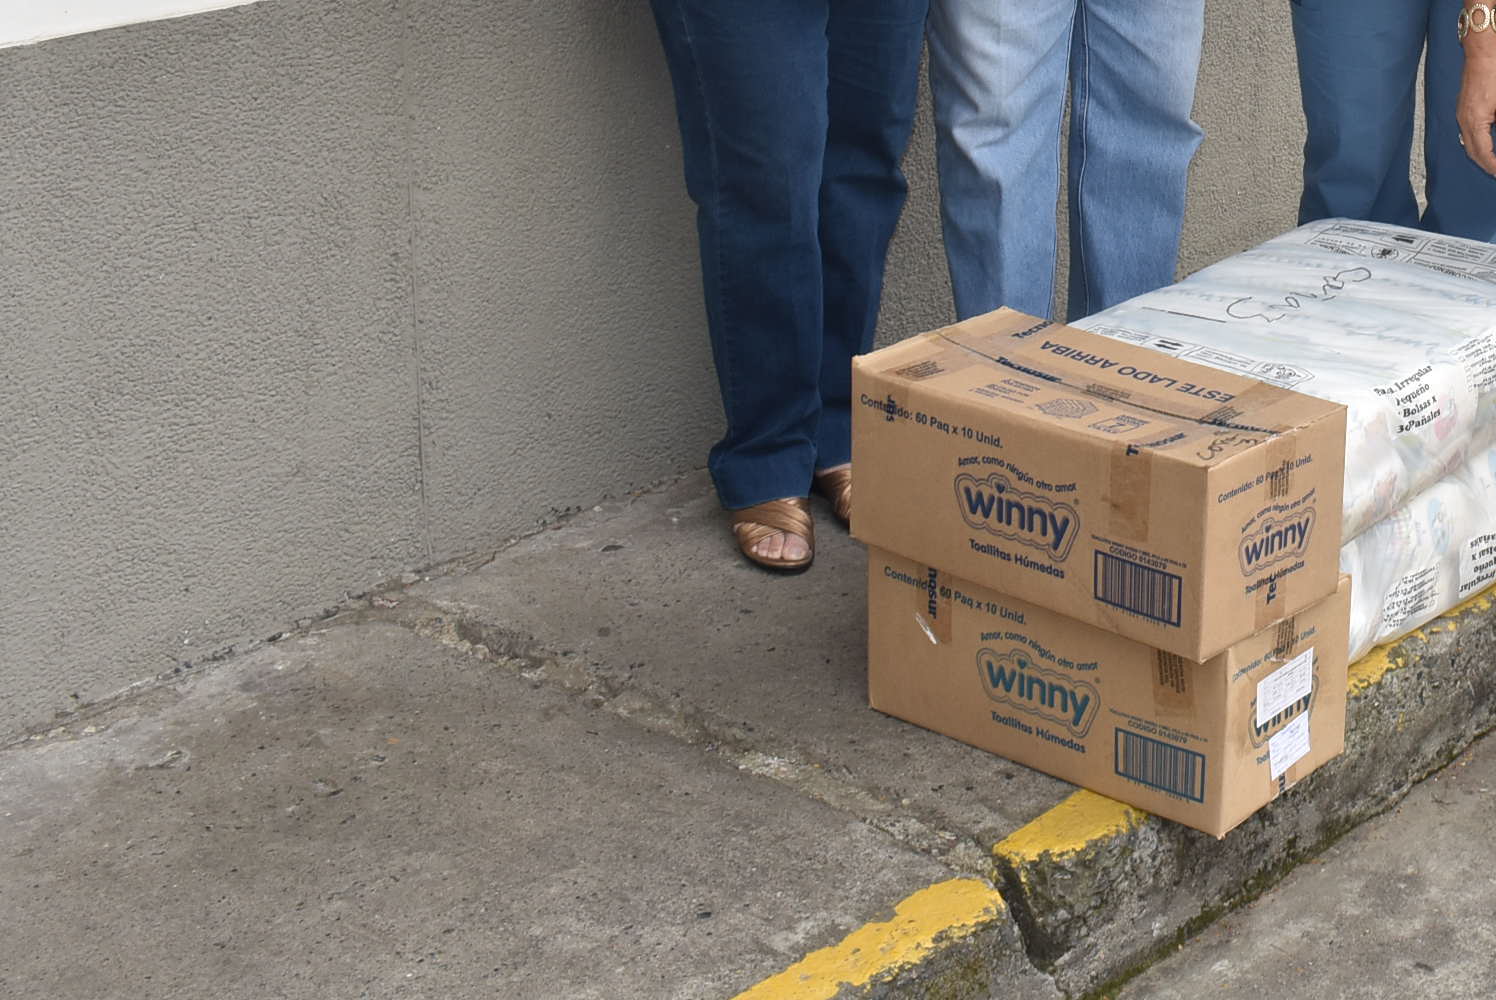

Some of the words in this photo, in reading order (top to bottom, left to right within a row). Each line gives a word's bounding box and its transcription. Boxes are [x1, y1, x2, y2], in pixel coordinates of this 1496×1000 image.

[1040, 340, 1120, 369] ARRIBA
[1117, 365, 1179, 390] LADO
[1176, 382, 1237, 404] ESTE
[1394, 364, 1433, 391] Irregular
[1402, 398, 1431, 418] Bolsas
[1408, 408, 1441, 428] Pañales
[915, 411, 927, 425] 60
[930, 416, 950, 435] Paq
[952, 425, 958, 435] x
[961, 426, 974, 440] 10
[976, 432, 1004, 449] Unid.
[958, 455, 981, 467] Amor,
[982, 455, 1005, 468] como
[1006, 463, 1034, 485] ningún
[1035, 480, 1053, 492] otro
[1055, 482, 1077, 493] amor
[964, 482, 1070, 552] winny
[969, 538, 1012, 563] Toallitas
[1014, 554, 1066, 580] Húmedas
[1244, 517, 1311, 566] winny
[1459, 569, 1496, 592] Irregular
[939, 585, 952, 599] 60
[954, 590, 974, 609] Paq
[975, 601, 982, 611] x
[984, 601, 997, 615] 10
[1000, 607, 1027, 625] Unid.
[1004, 631, 1028, 645] como
[1028, 639, 1056, 662] ningún
[1056, 657, 1074, 669] otro
[1076, 661, 1098, 672] amor
[986, 657, 1090, 727] winny
[991, 711, 1034, 735] Toallitas
[1035, 727, 1087, 754] Húmedas
